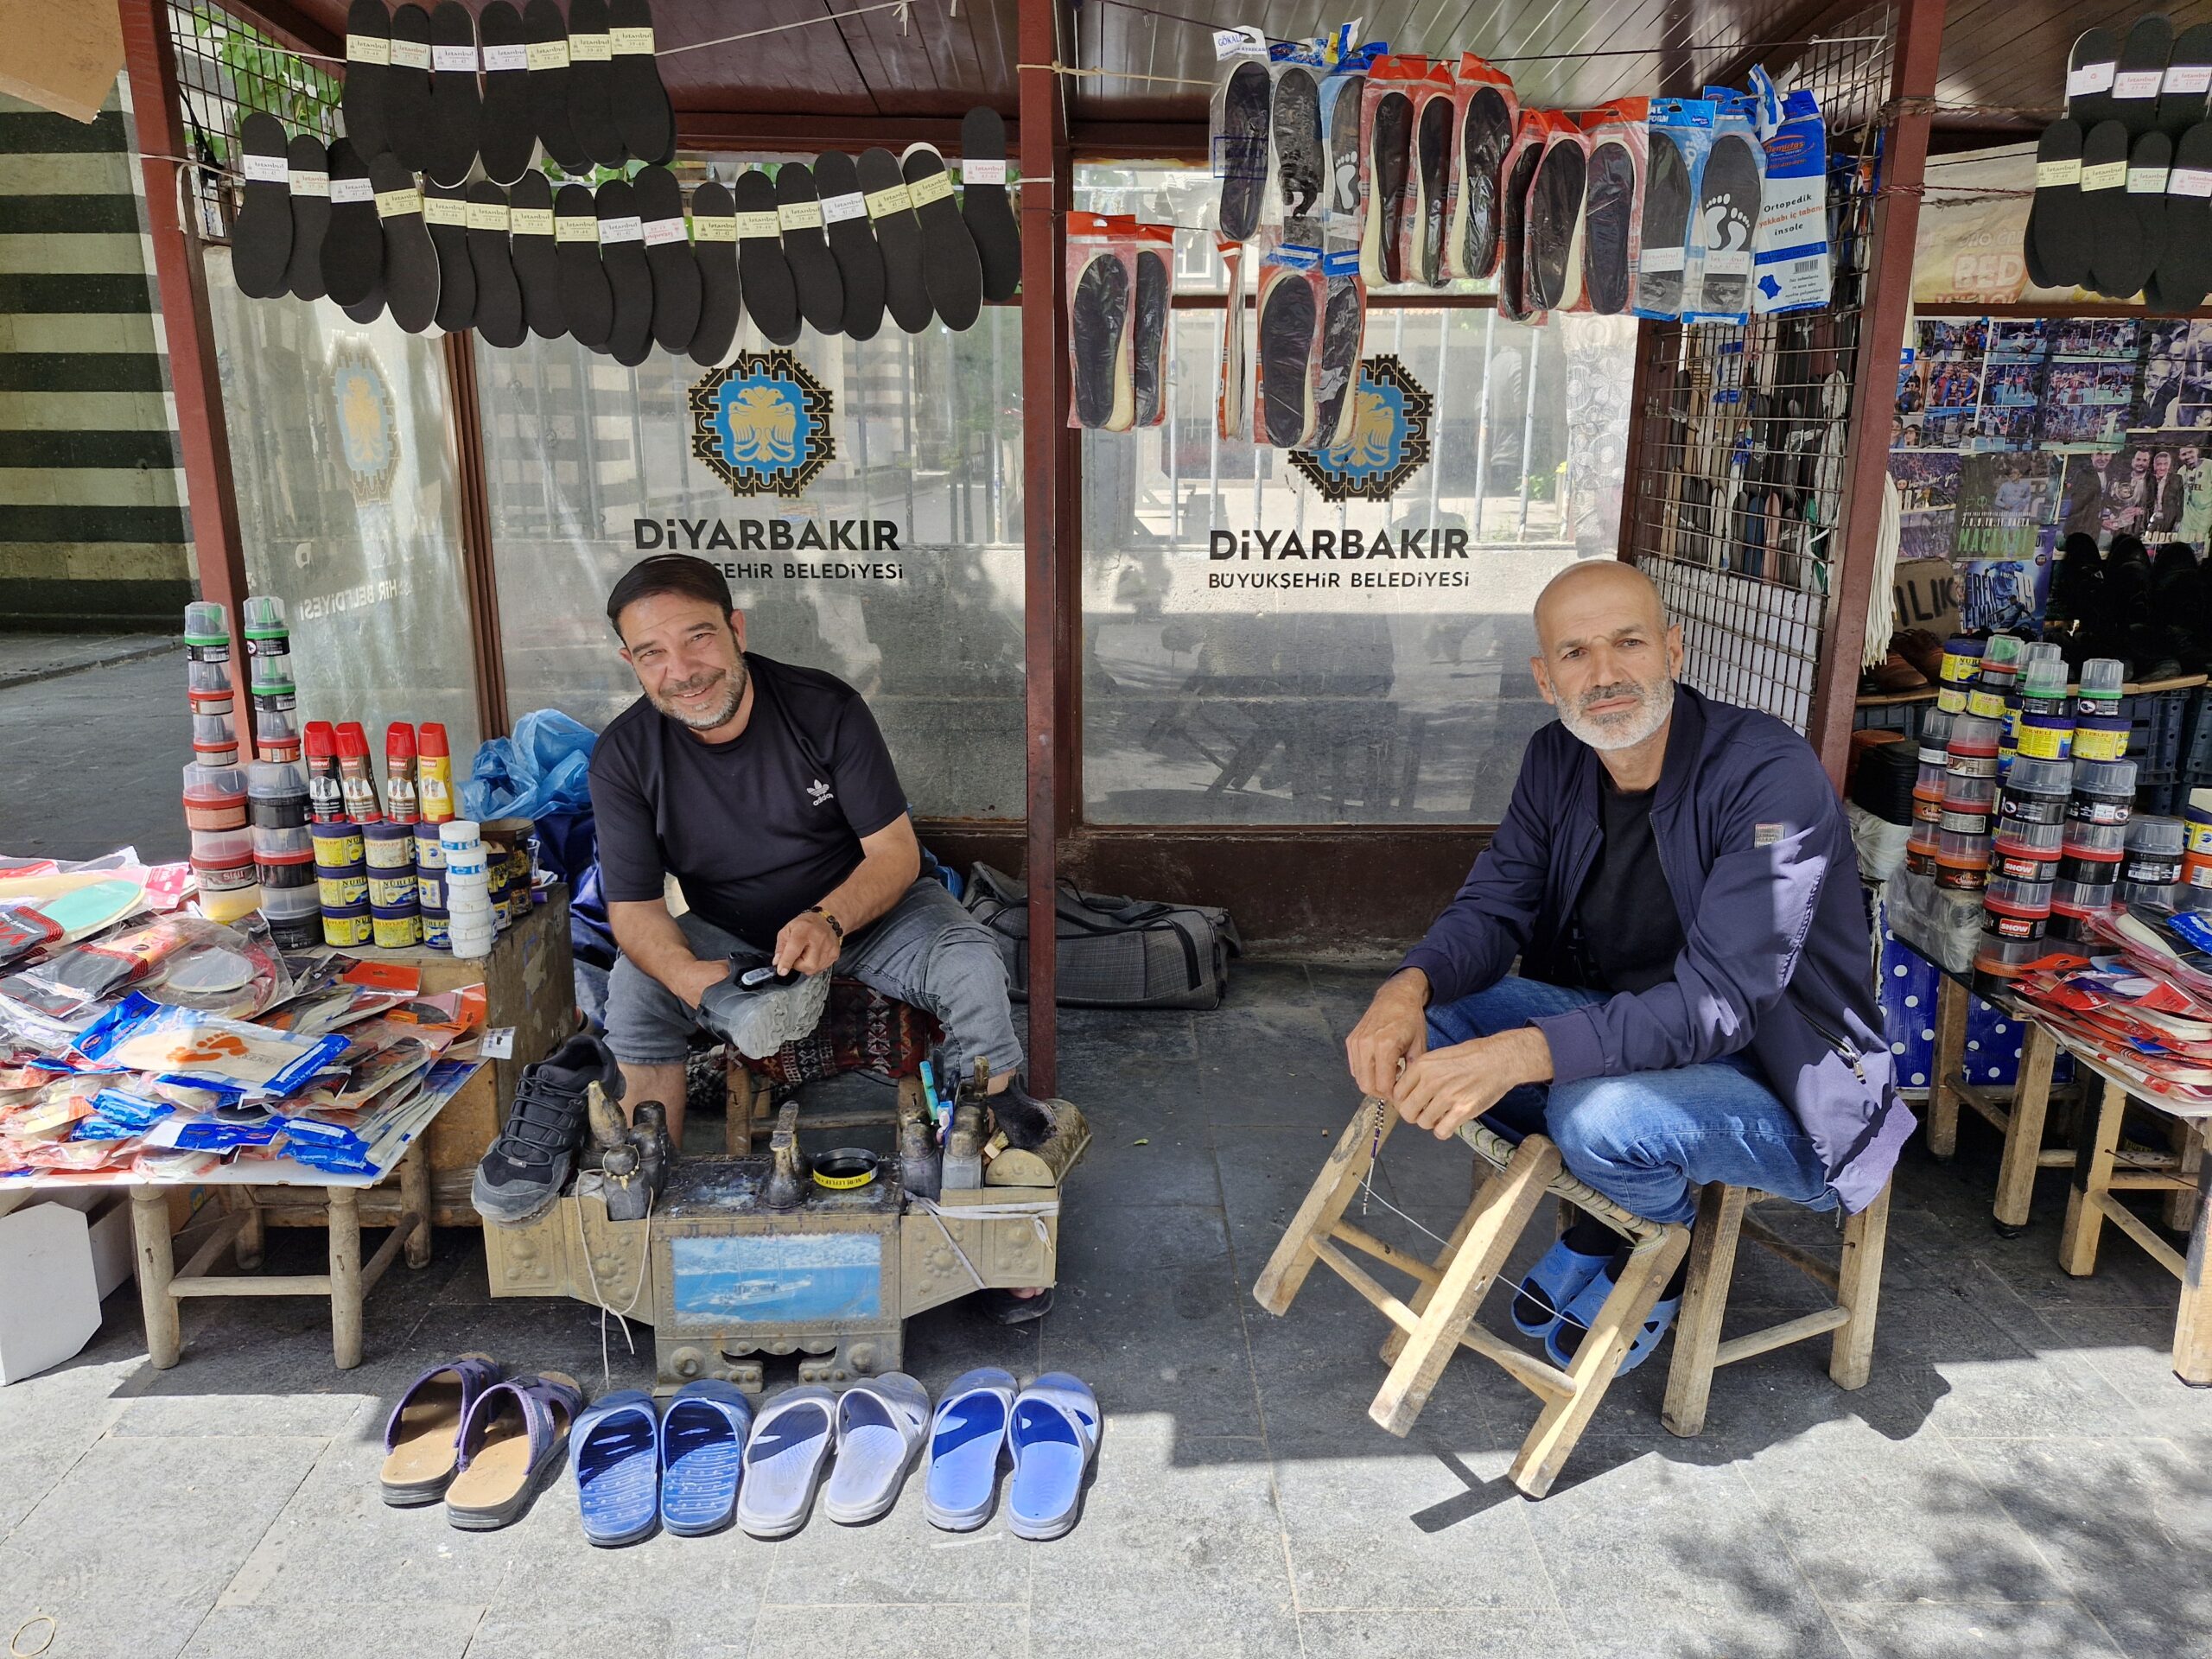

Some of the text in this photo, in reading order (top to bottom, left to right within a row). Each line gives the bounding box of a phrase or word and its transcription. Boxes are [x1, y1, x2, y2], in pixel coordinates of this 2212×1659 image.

[1764, 194, 1812, 213] Ortopedik
[1789, 211, 1797, 219] iç
[1774, 223, 1803, 236] insole
[2004, 862, 2033, 874] SHOW
[1999, 922, 2029, 933] SHOW
